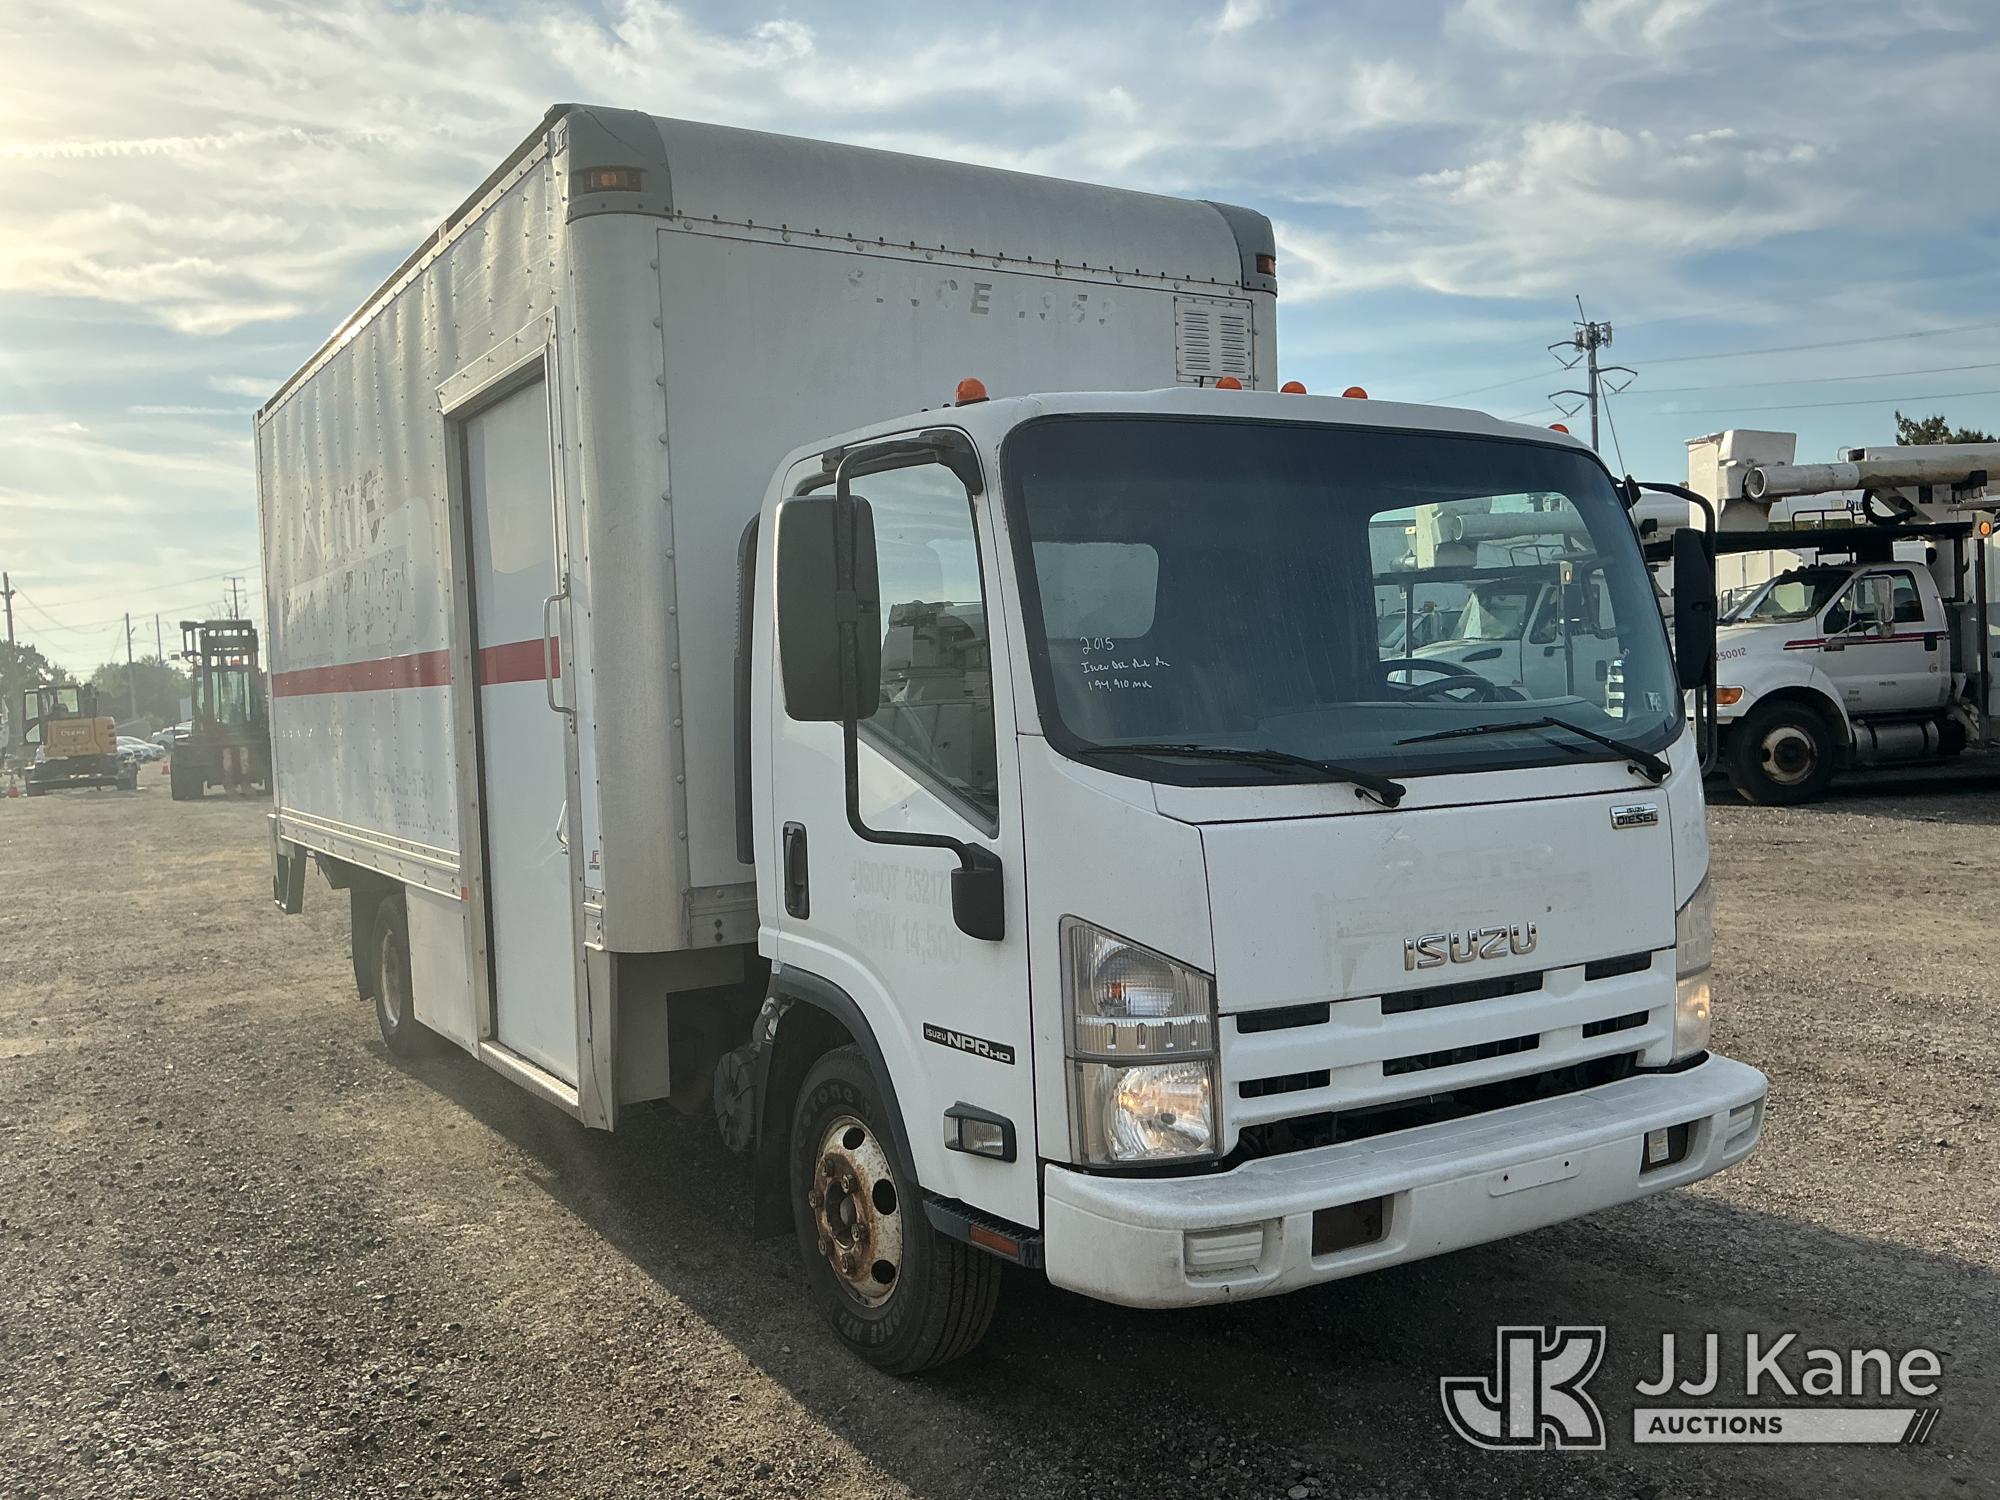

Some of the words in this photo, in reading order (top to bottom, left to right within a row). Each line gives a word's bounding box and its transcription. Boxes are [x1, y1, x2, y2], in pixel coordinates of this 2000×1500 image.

[1079, 636, 1115, 655] 2015
[1616, 812, 1659, 826] DIESEL
[1403, 921, 1538, 971] ISUZU
[925, 1027, 947, 1041] ISUZU
